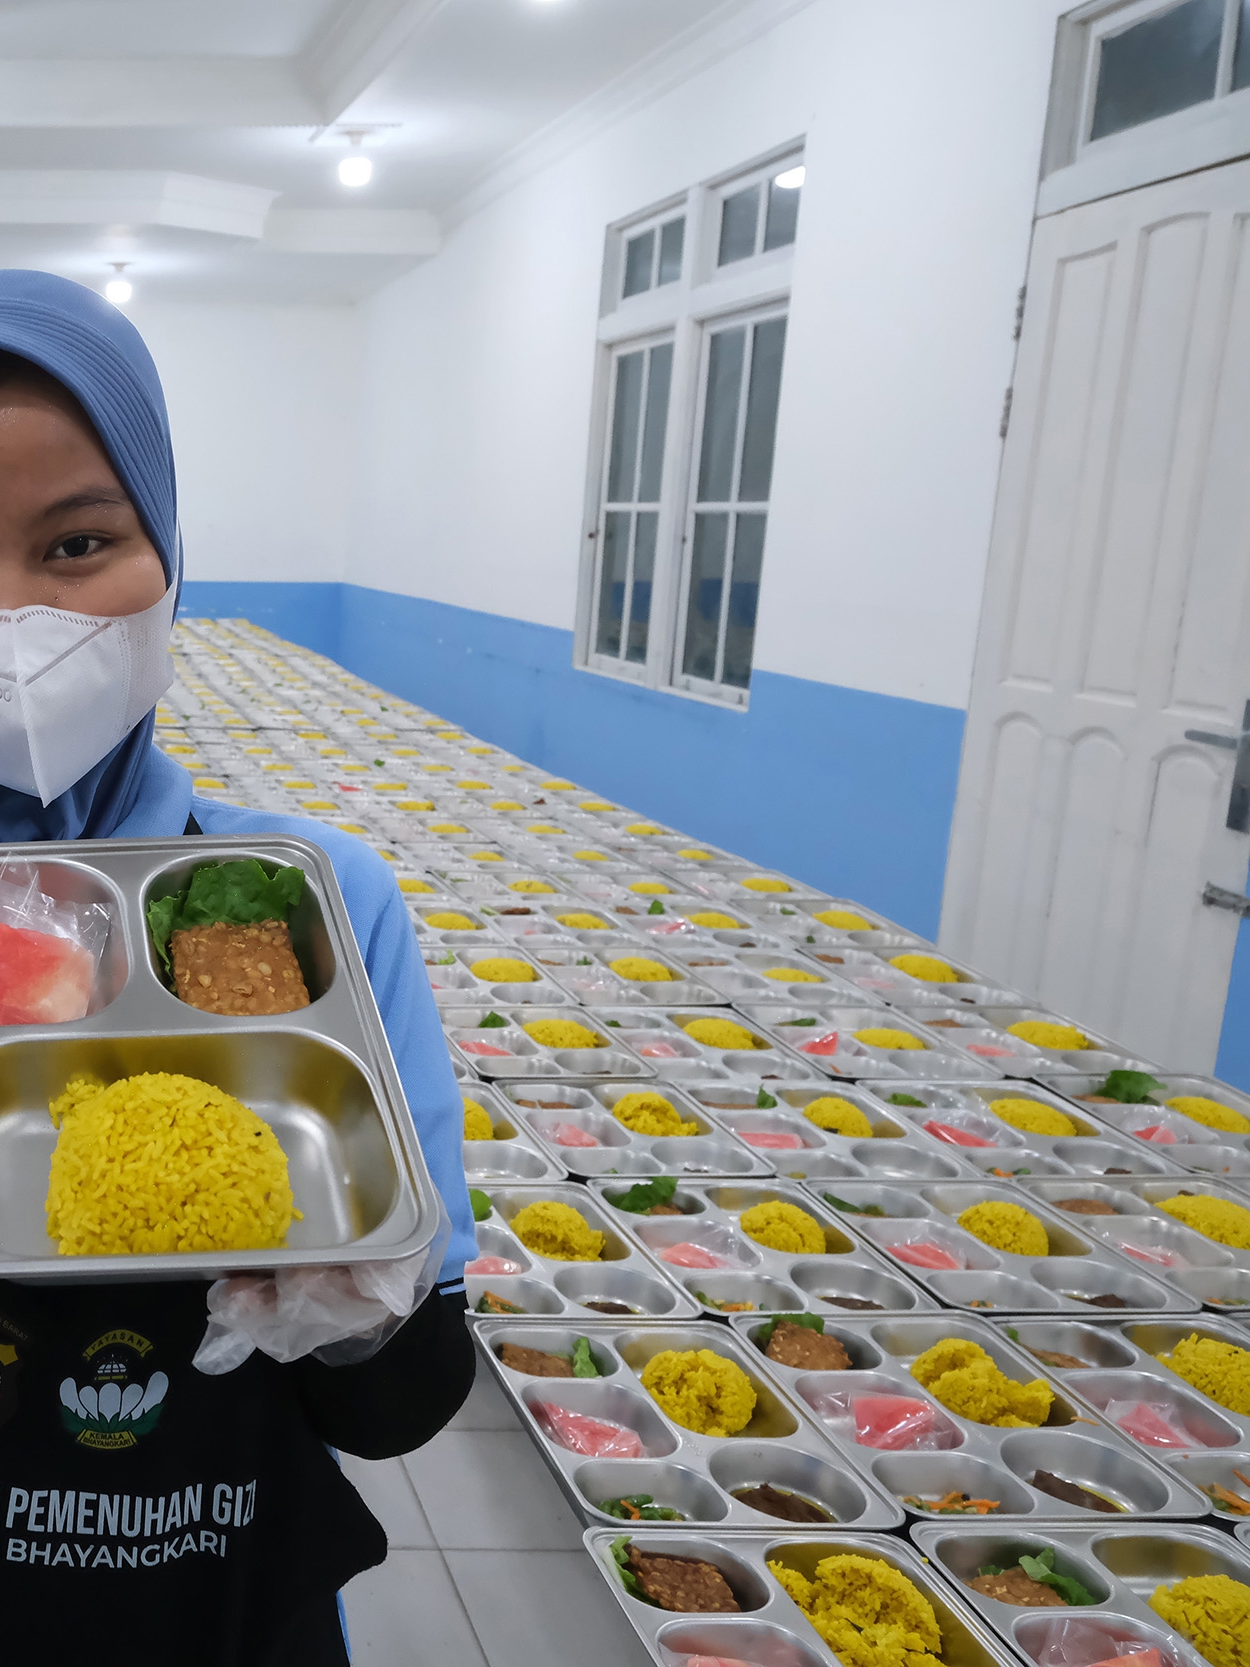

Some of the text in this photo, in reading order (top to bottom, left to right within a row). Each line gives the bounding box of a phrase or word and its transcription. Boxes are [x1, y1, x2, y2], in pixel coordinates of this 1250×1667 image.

[2, 1319, 30, 1342] BARAT
[91, 1332, 145, 1351] YAYASAN
[89, 1432, 125, 1440] KEMALA
[5, 1483, 203, 1538] PEMENUHAN
[6, 1529, 227, 1569] BHAYANGKARI
